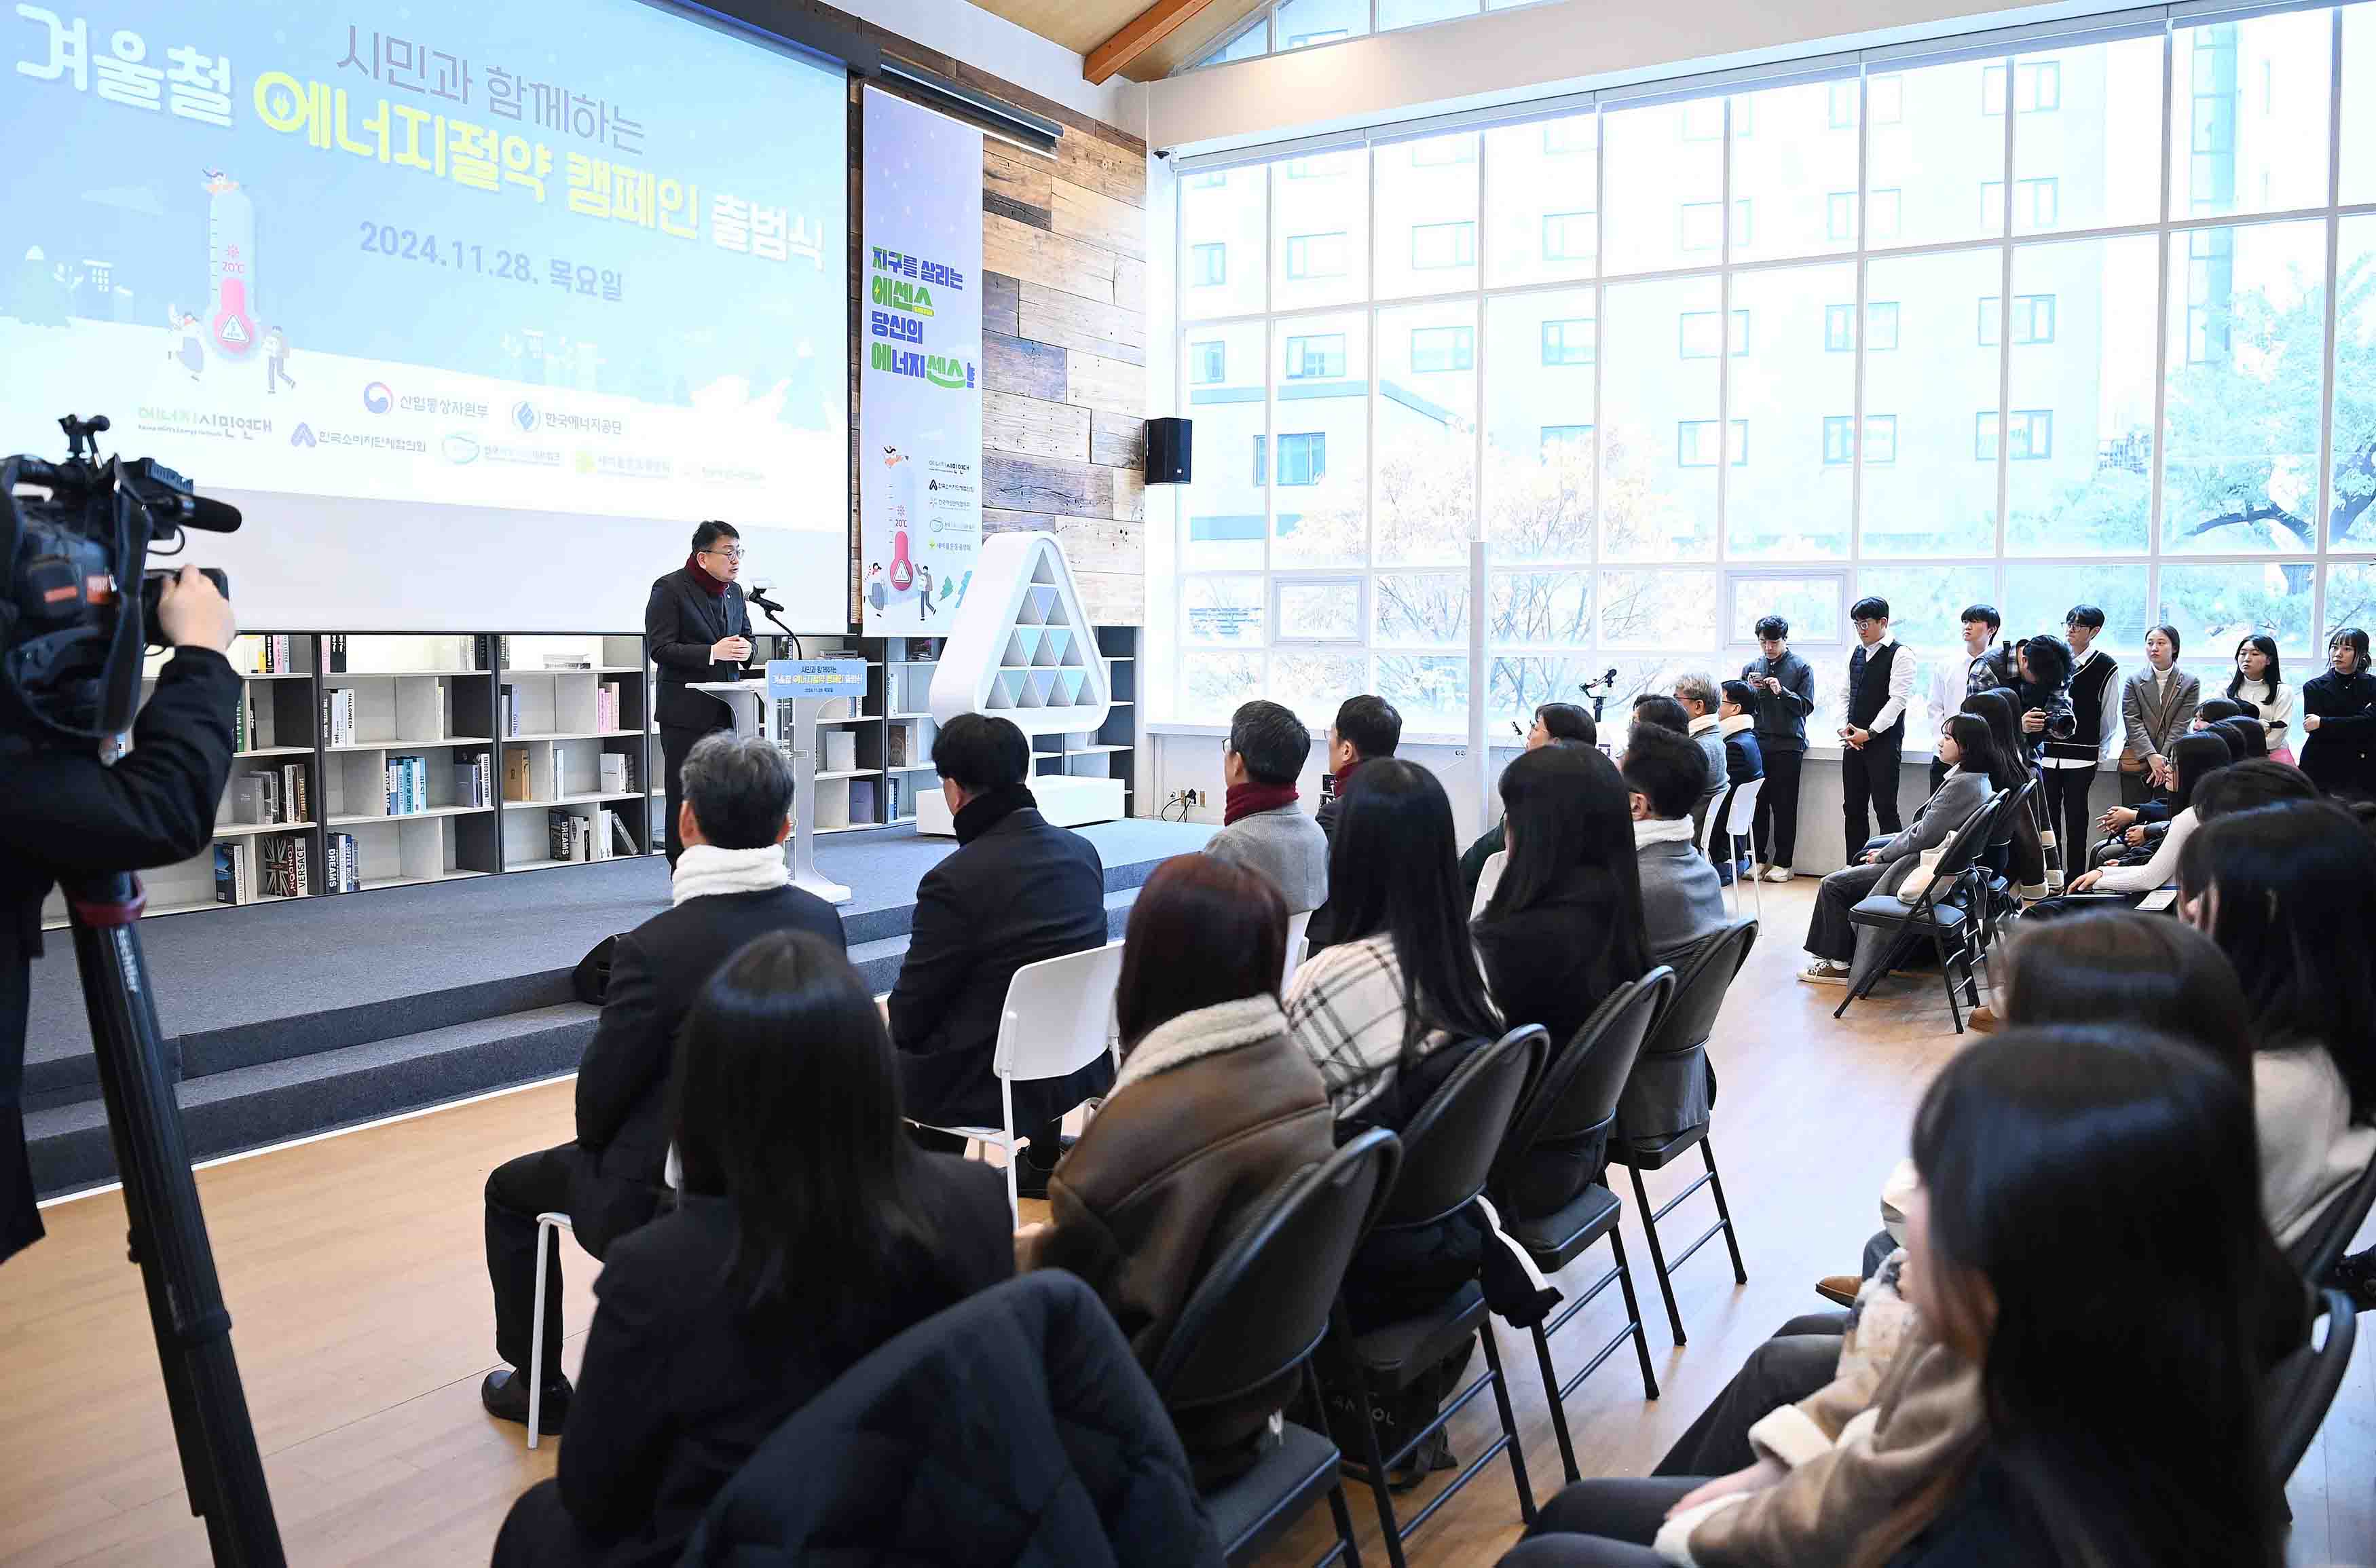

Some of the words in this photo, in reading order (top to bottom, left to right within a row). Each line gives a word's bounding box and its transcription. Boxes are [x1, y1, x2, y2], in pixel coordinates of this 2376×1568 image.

[337, 24, 473, 105] 시민과
[485, 65, 644, 155] 함께하는
[15, 3, 234, 128] 겨울철
[254, 71, 553, 203] 에너지절약
[565, 151, 699, 240] 캠페인
[710, 193, 825, 273] 출범식
[359, 220, 538, 285] 2024.11.28.
[549, 257, 623, 302] 목요일
[872, 245, 918, 279] 지구를
[921, 259, 963, 291] 살리는
[871, 275, 935, 316] 에센스
[871, 310, 923, 345] 당신의
[399, 395, 489, 418] 산업통상자원부
[544, 411, 623, 435] 한국에너지공단
[561, 821, 570, 855] DREAMS
[297, 846, 306, 888] VERSACE
[328, 848, 337, 887] DREAMS
